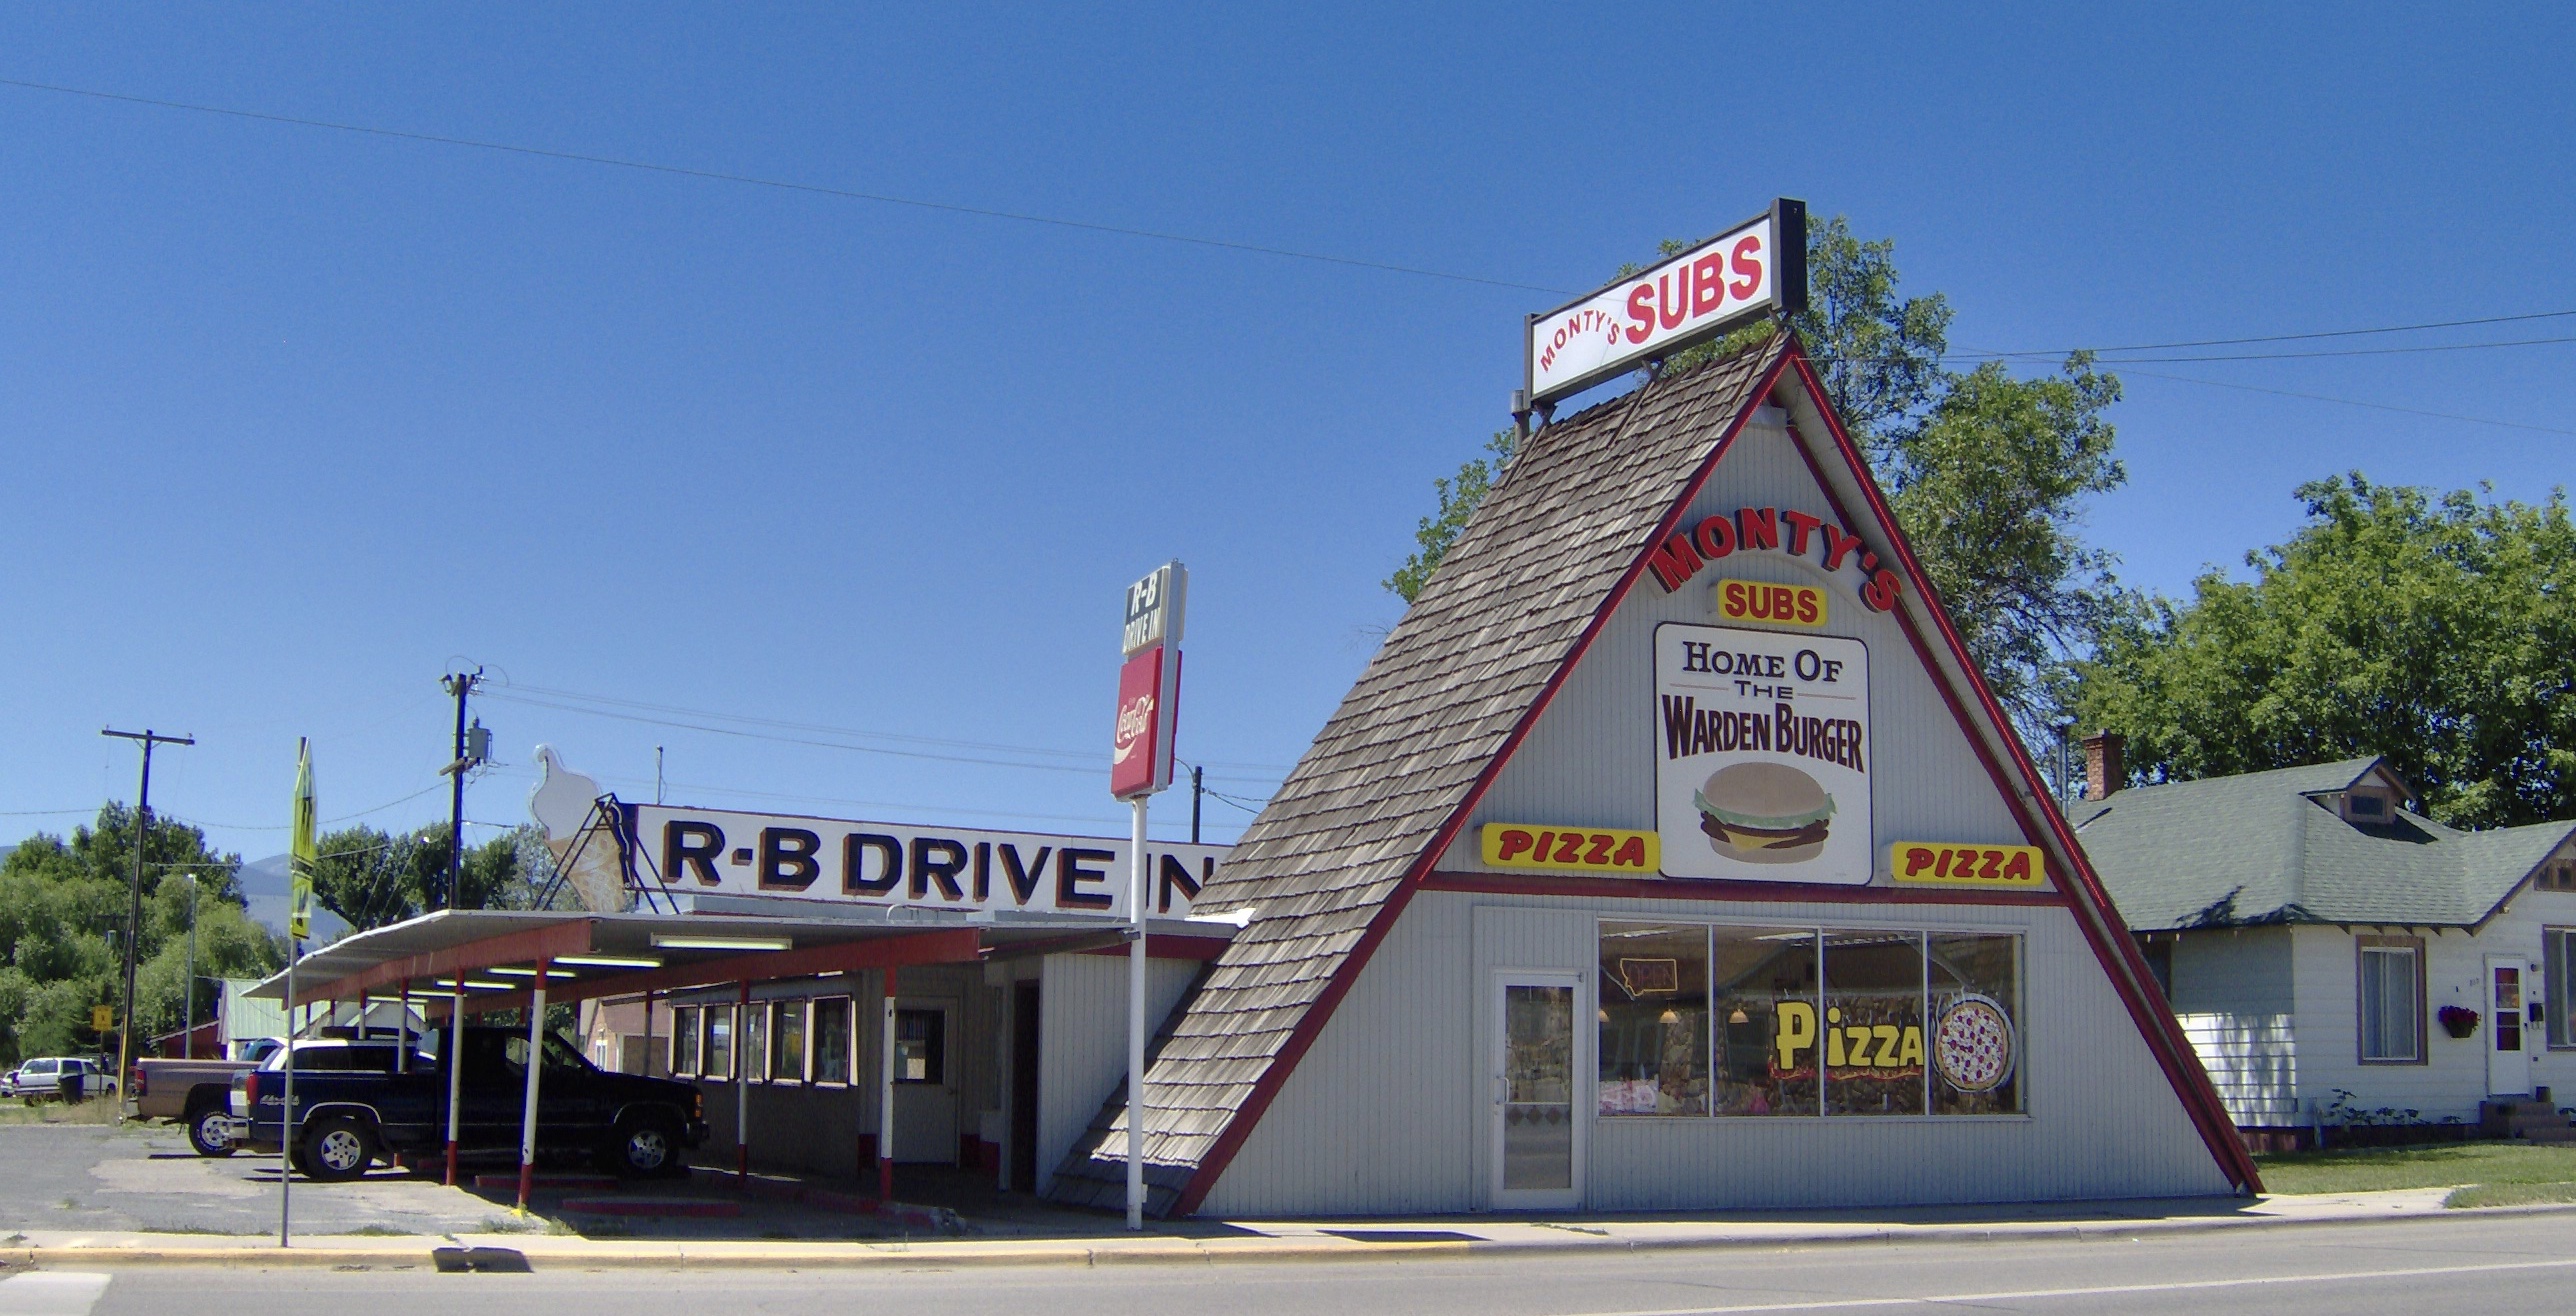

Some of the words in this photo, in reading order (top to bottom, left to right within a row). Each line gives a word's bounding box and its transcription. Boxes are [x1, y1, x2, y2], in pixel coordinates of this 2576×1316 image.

[1540, 309, 1620, 374] MONTY'S
[1625, 235, 1762, 345] SUBS
[1649, 507, 1902, 613] MONTY'S
[1130, 571, 1158, 617] R-B
[1725, 583, 1819, 623] SUBS
[1682, 641, 1785, 678] HOME
[1794, 649, 1843, 683] OF
[1734, 680, 1795, 700] THE
[1662, 694, 1771, 760] WARDEN
[1775, 702, 1865, 774] BURGER
[662, 820, 821, 892] R-B
[842, 833, 1115, 911] DRIVE
[1498, 830, 1645, 867] PIZZA
[1905, 848, 2031, 880] PIZZA
